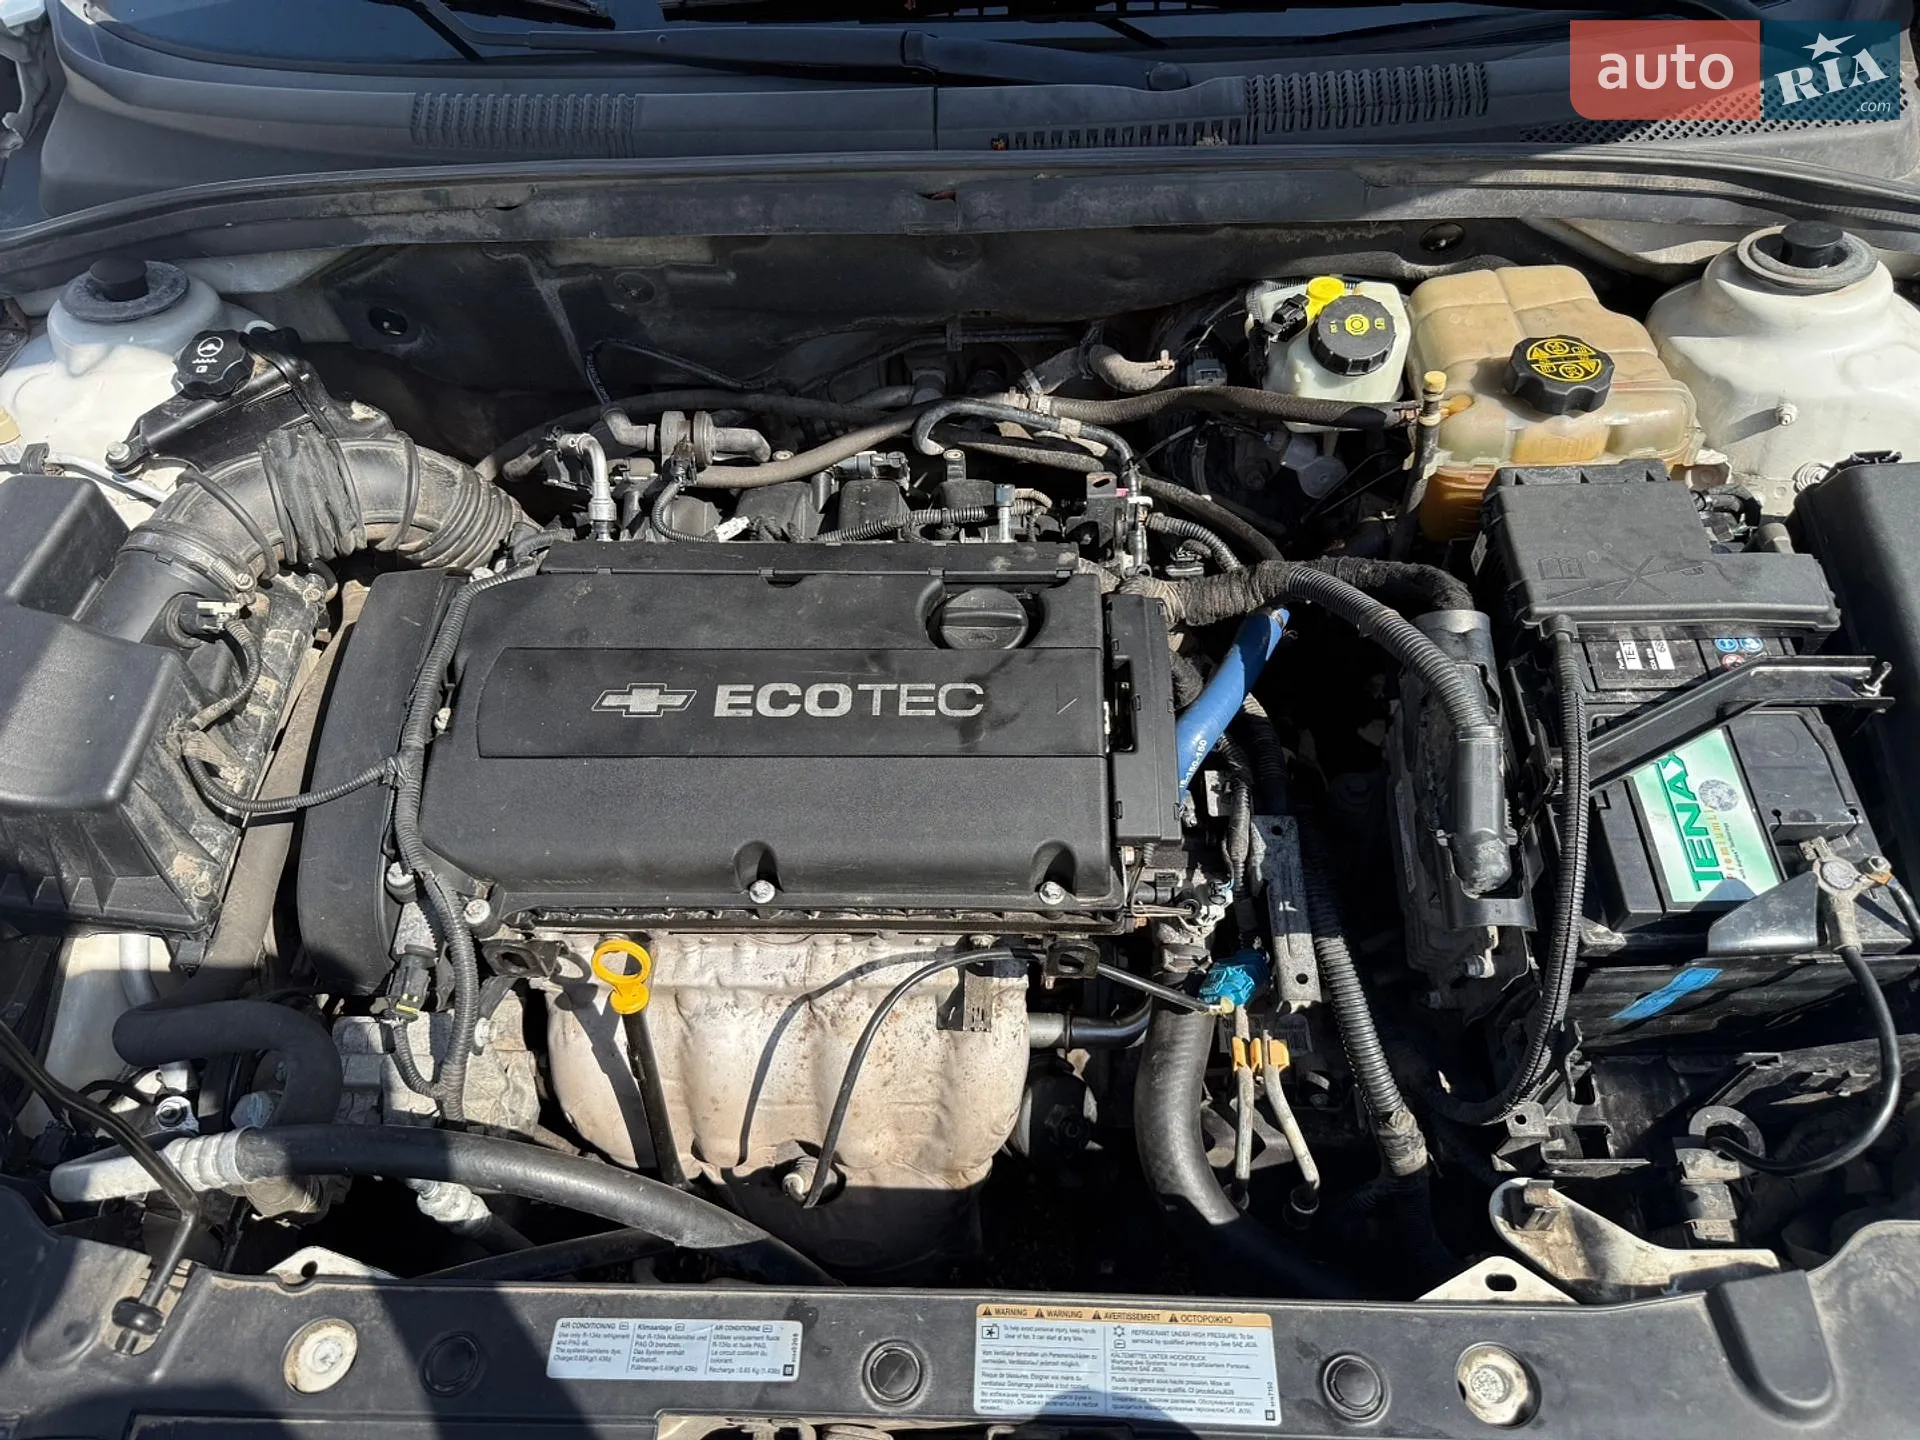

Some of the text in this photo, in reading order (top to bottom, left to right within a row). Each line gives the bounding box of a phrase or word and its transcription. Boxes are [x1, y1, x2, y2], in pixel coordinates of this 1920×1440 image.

[714, 682, 984, 717] ECOTEC
[994, 1308, 1161, 1321] WARNING WARNUNG AVERTISSEMENT
[1180, 1314, 1233, 1324] ОСТОРОЖНО
[572, 1322, 616, 1330] CONDITIONING
